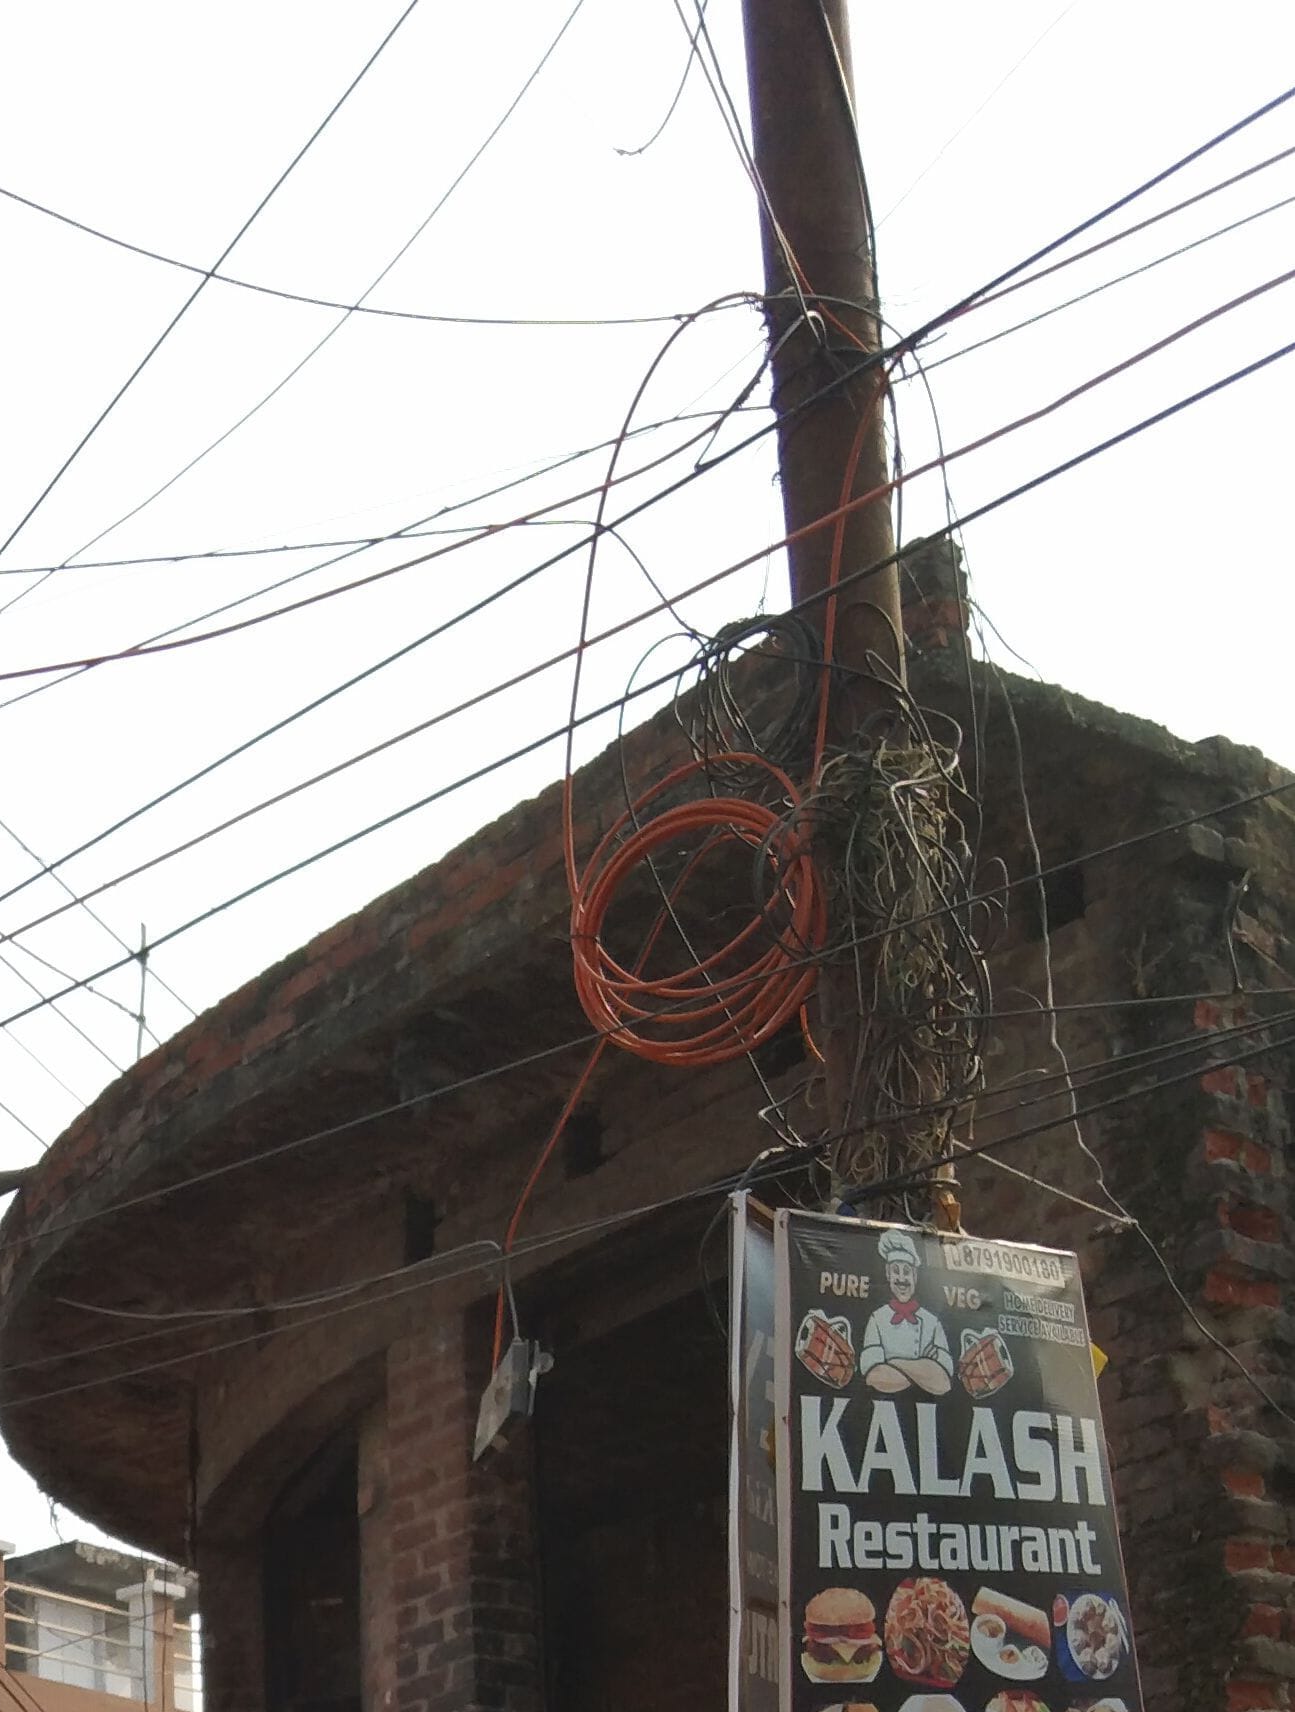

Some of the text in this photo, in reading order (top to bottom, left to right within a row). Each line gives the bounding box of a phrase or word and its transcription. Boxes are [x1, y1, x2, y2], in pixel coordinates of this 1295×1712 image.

[819, 1270, 982, 1311] PURE VEG
[799, 1393, 1108, 1506] KALASH
[817, 1501, 1103, 1576] Restaurant
